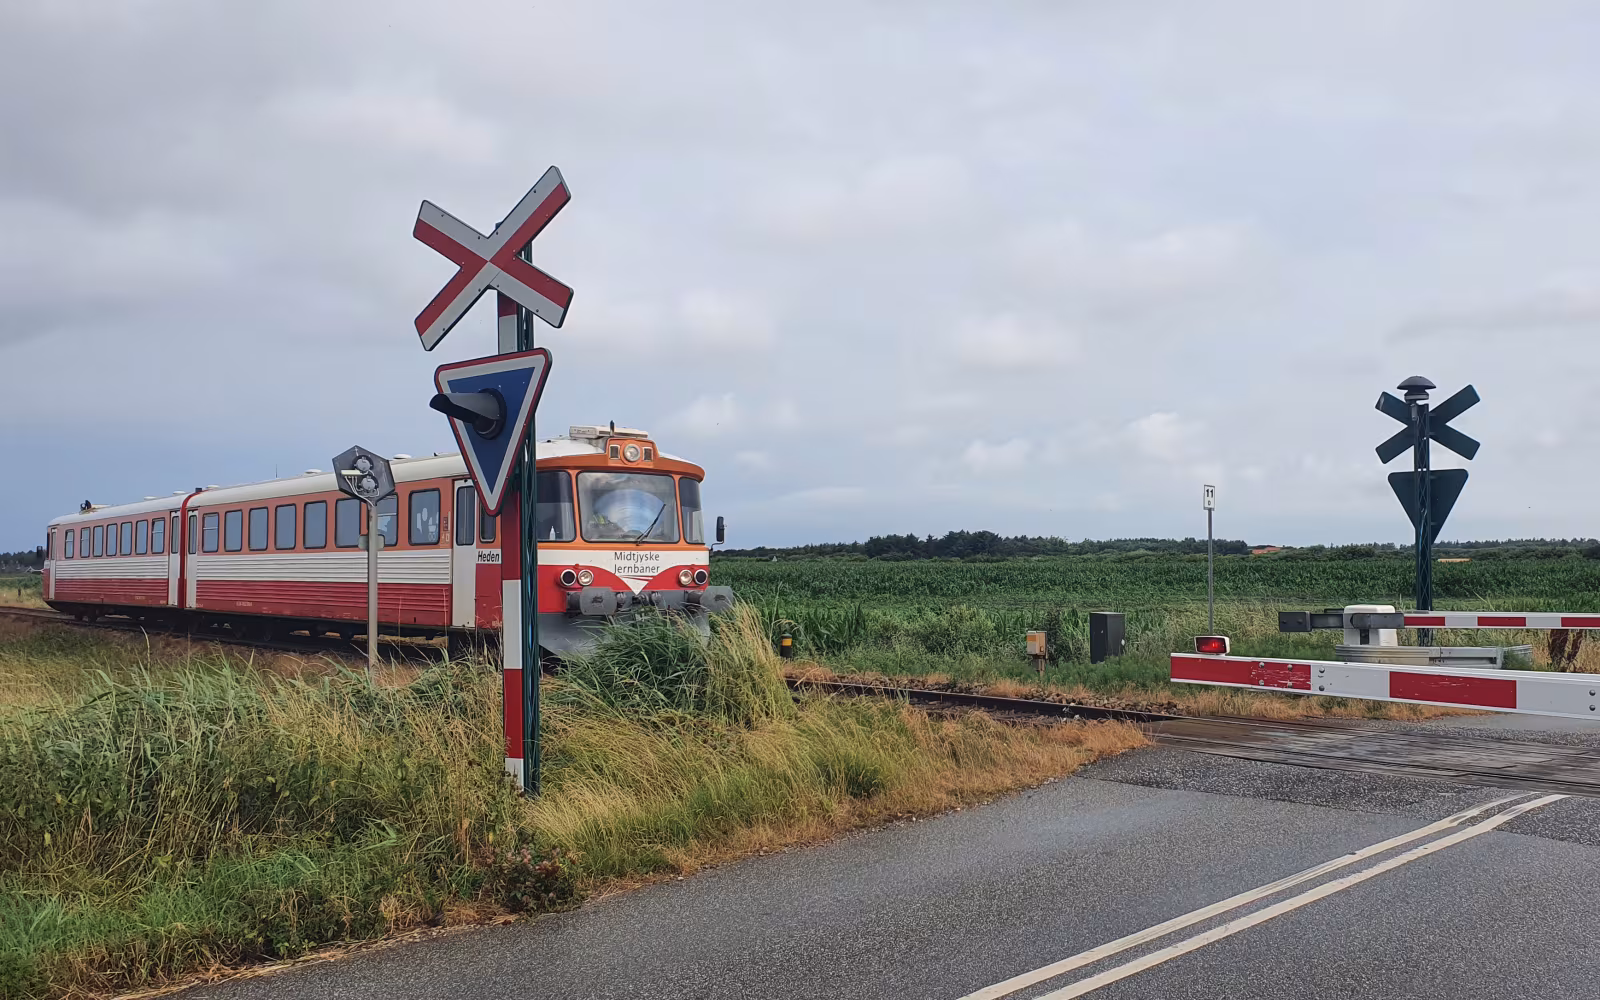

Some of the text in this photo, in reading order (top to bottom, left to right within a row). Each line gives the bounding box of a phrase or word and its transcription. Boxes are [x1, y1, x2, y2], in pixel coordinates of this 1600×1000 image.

[1206, 489, 1213, 498] 11
[477, 550, 500, 562] Heden
[614, 551, 660, 563] Midtjyske
[614, 563, 660, 574] Jernbaner
